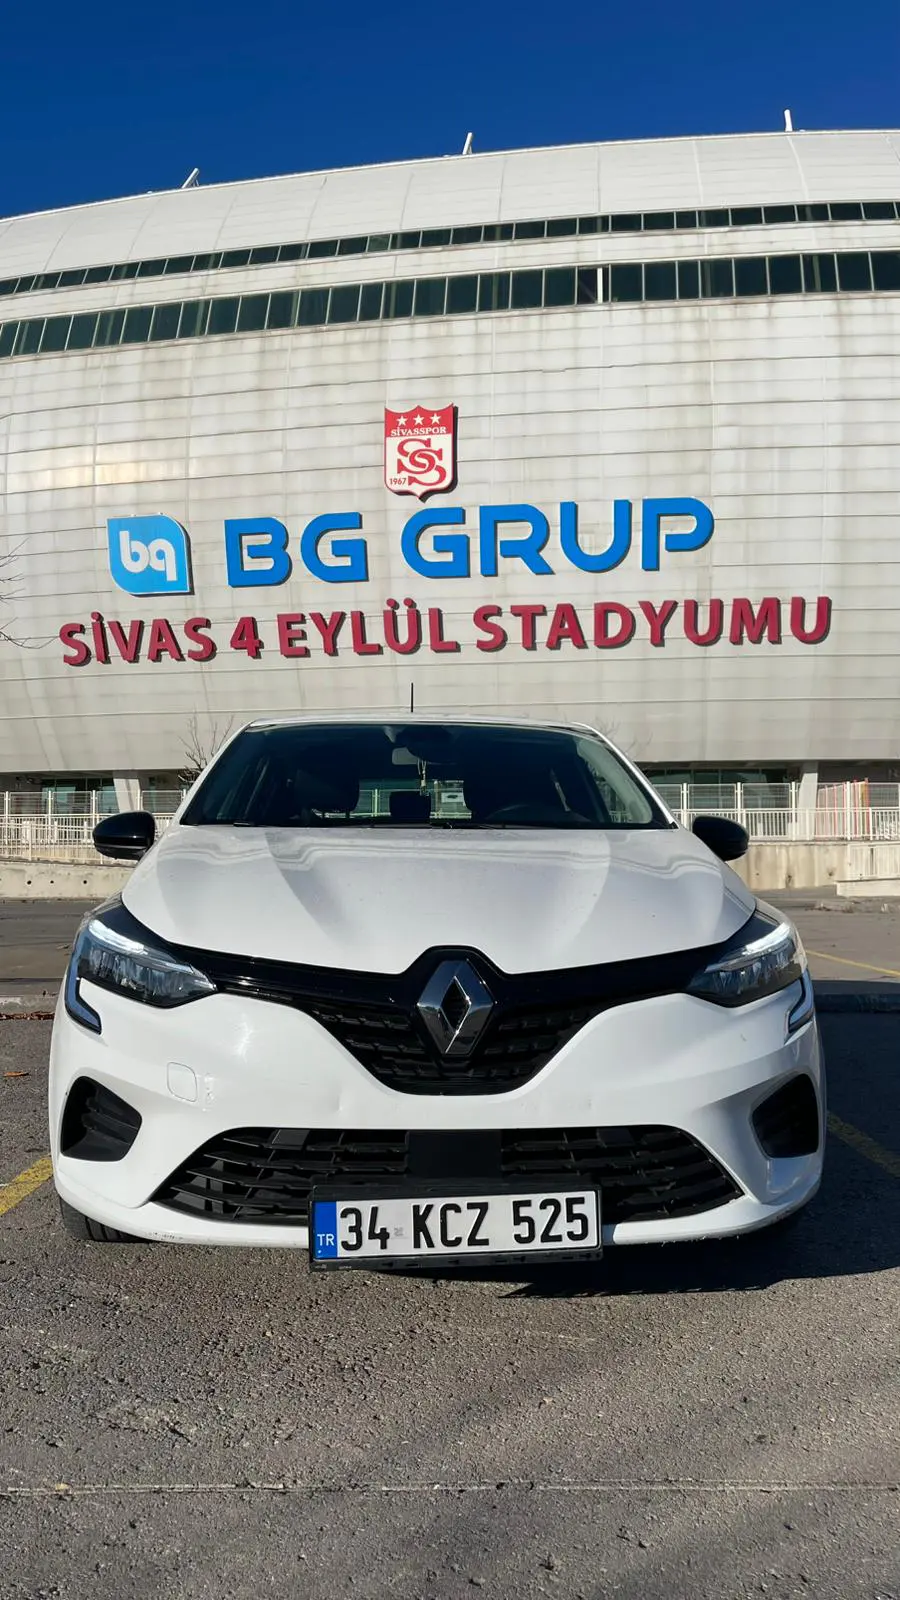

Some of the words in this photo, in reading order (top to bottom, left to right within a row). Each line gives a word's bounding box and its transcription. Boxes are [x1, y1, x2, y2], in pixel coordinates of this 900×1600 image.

[390, 426, 447, 437] SİVASSPOR
[389, 477, 407, 485] 1967
[224, 511, 368, 587] BG
[400, 497, 714, 578] GRUP
[58, 611, 216, 666] SİVAS
[230, 616, 263, 659] 4
[276, 597, 461, 658] EYLÜL
[473, 596, 832, 653] STADYUMU
[317, 1233, 334, 1246] TR
[340, 1206, 390, 1251] 34
[412, 1202, 490, 1249] KCZ
[512, 1196, 589, 1244] 525
